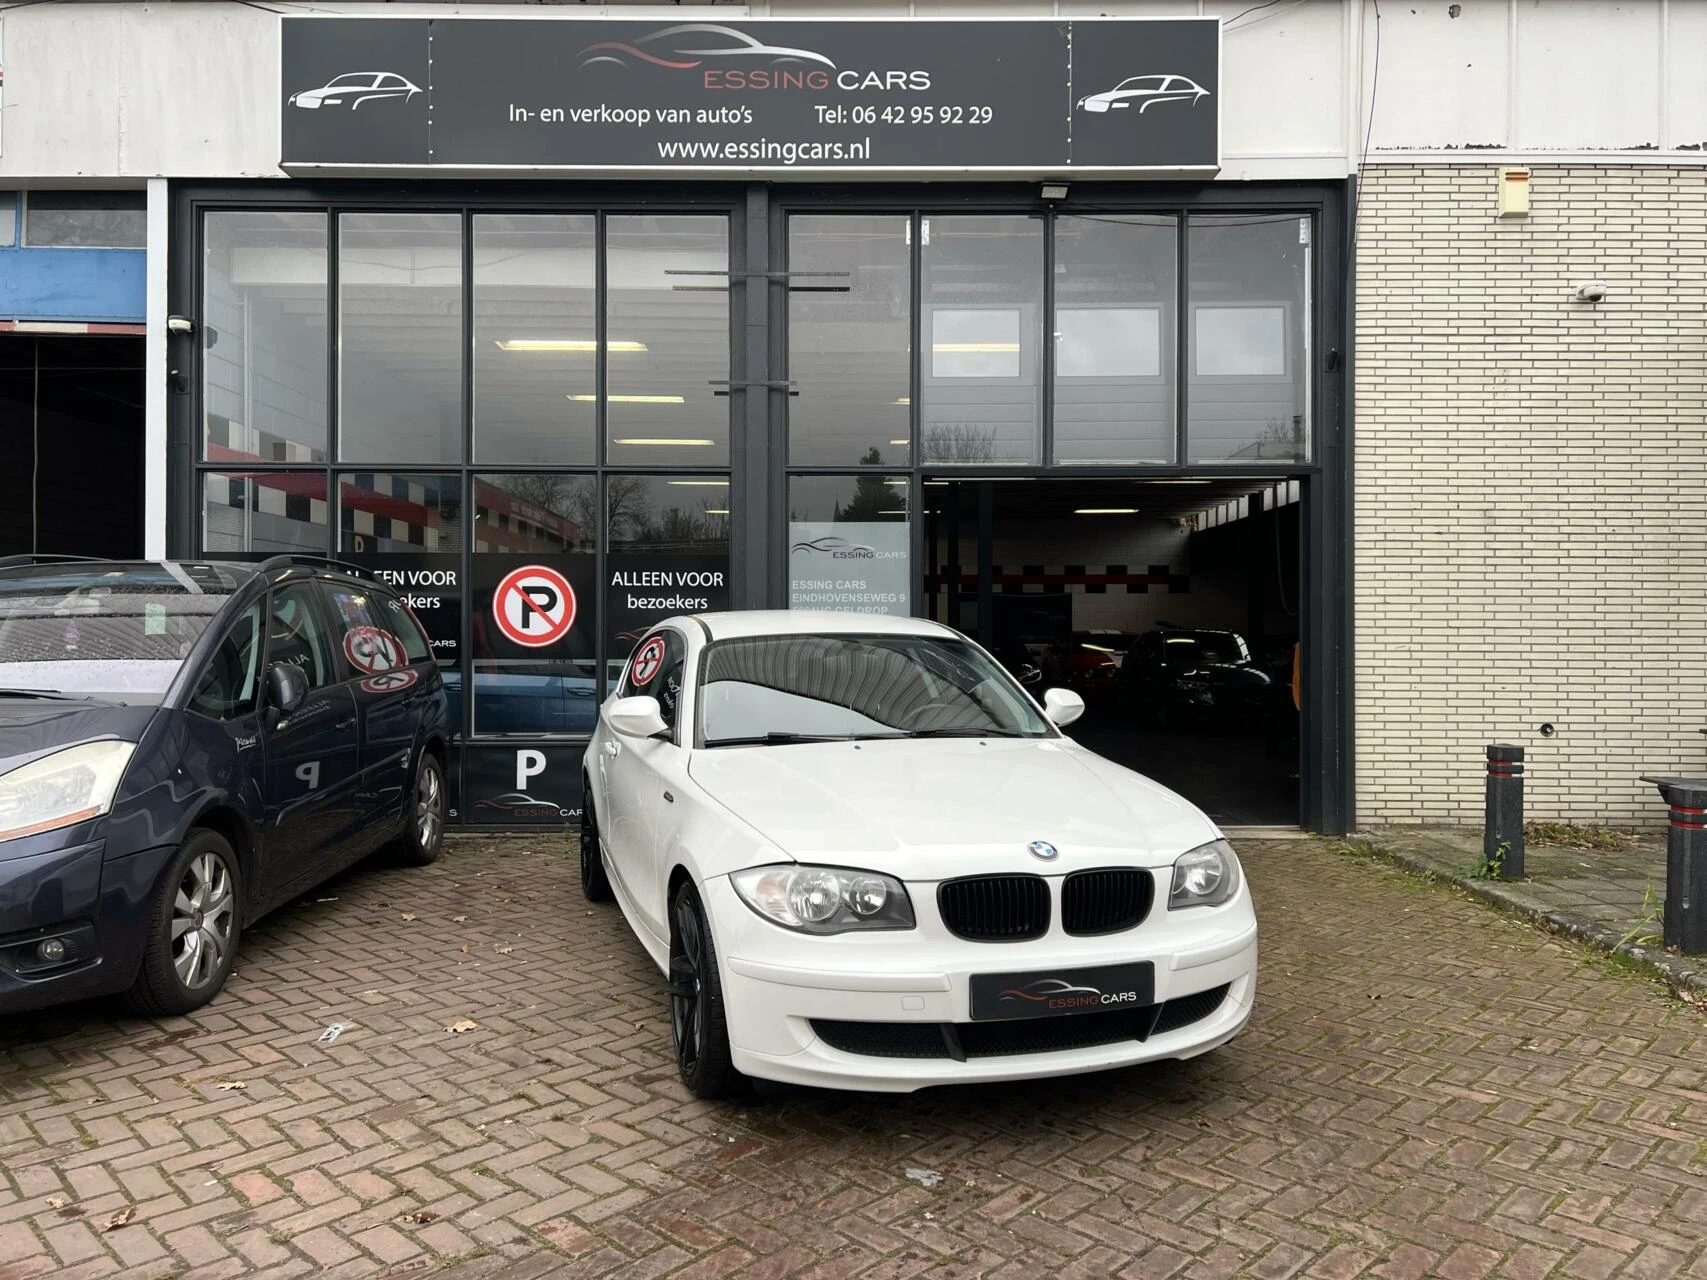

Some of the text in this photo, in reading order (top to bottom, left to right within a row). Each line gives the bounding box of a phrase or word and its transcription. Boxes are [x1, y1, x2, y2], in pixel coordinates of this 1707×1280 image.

[704, 70, 931, 91] ESSING CARS
[509, 104, 753, 127] In- en verkoop van auto's
[815, 105, 993, 124] Tel: 06 42 95 92 29
[657, 137, 870, 163] www.essingcars.nl
[832, 551, 907, 559] ESSING CARS
[407, 570, 457, 586] VOOR
[611, 571, 724, 587] ALLEEN VOOR
[792, 580, 867, 590] ESSING CARS
[627, 594, 708, 609] bezoekers
[792, 593, 906, 603] EINDHOVENSEWEG 9
[516, 749, 547, 790] P
[1049, 991, 1137, 1009] ESSING CARS
